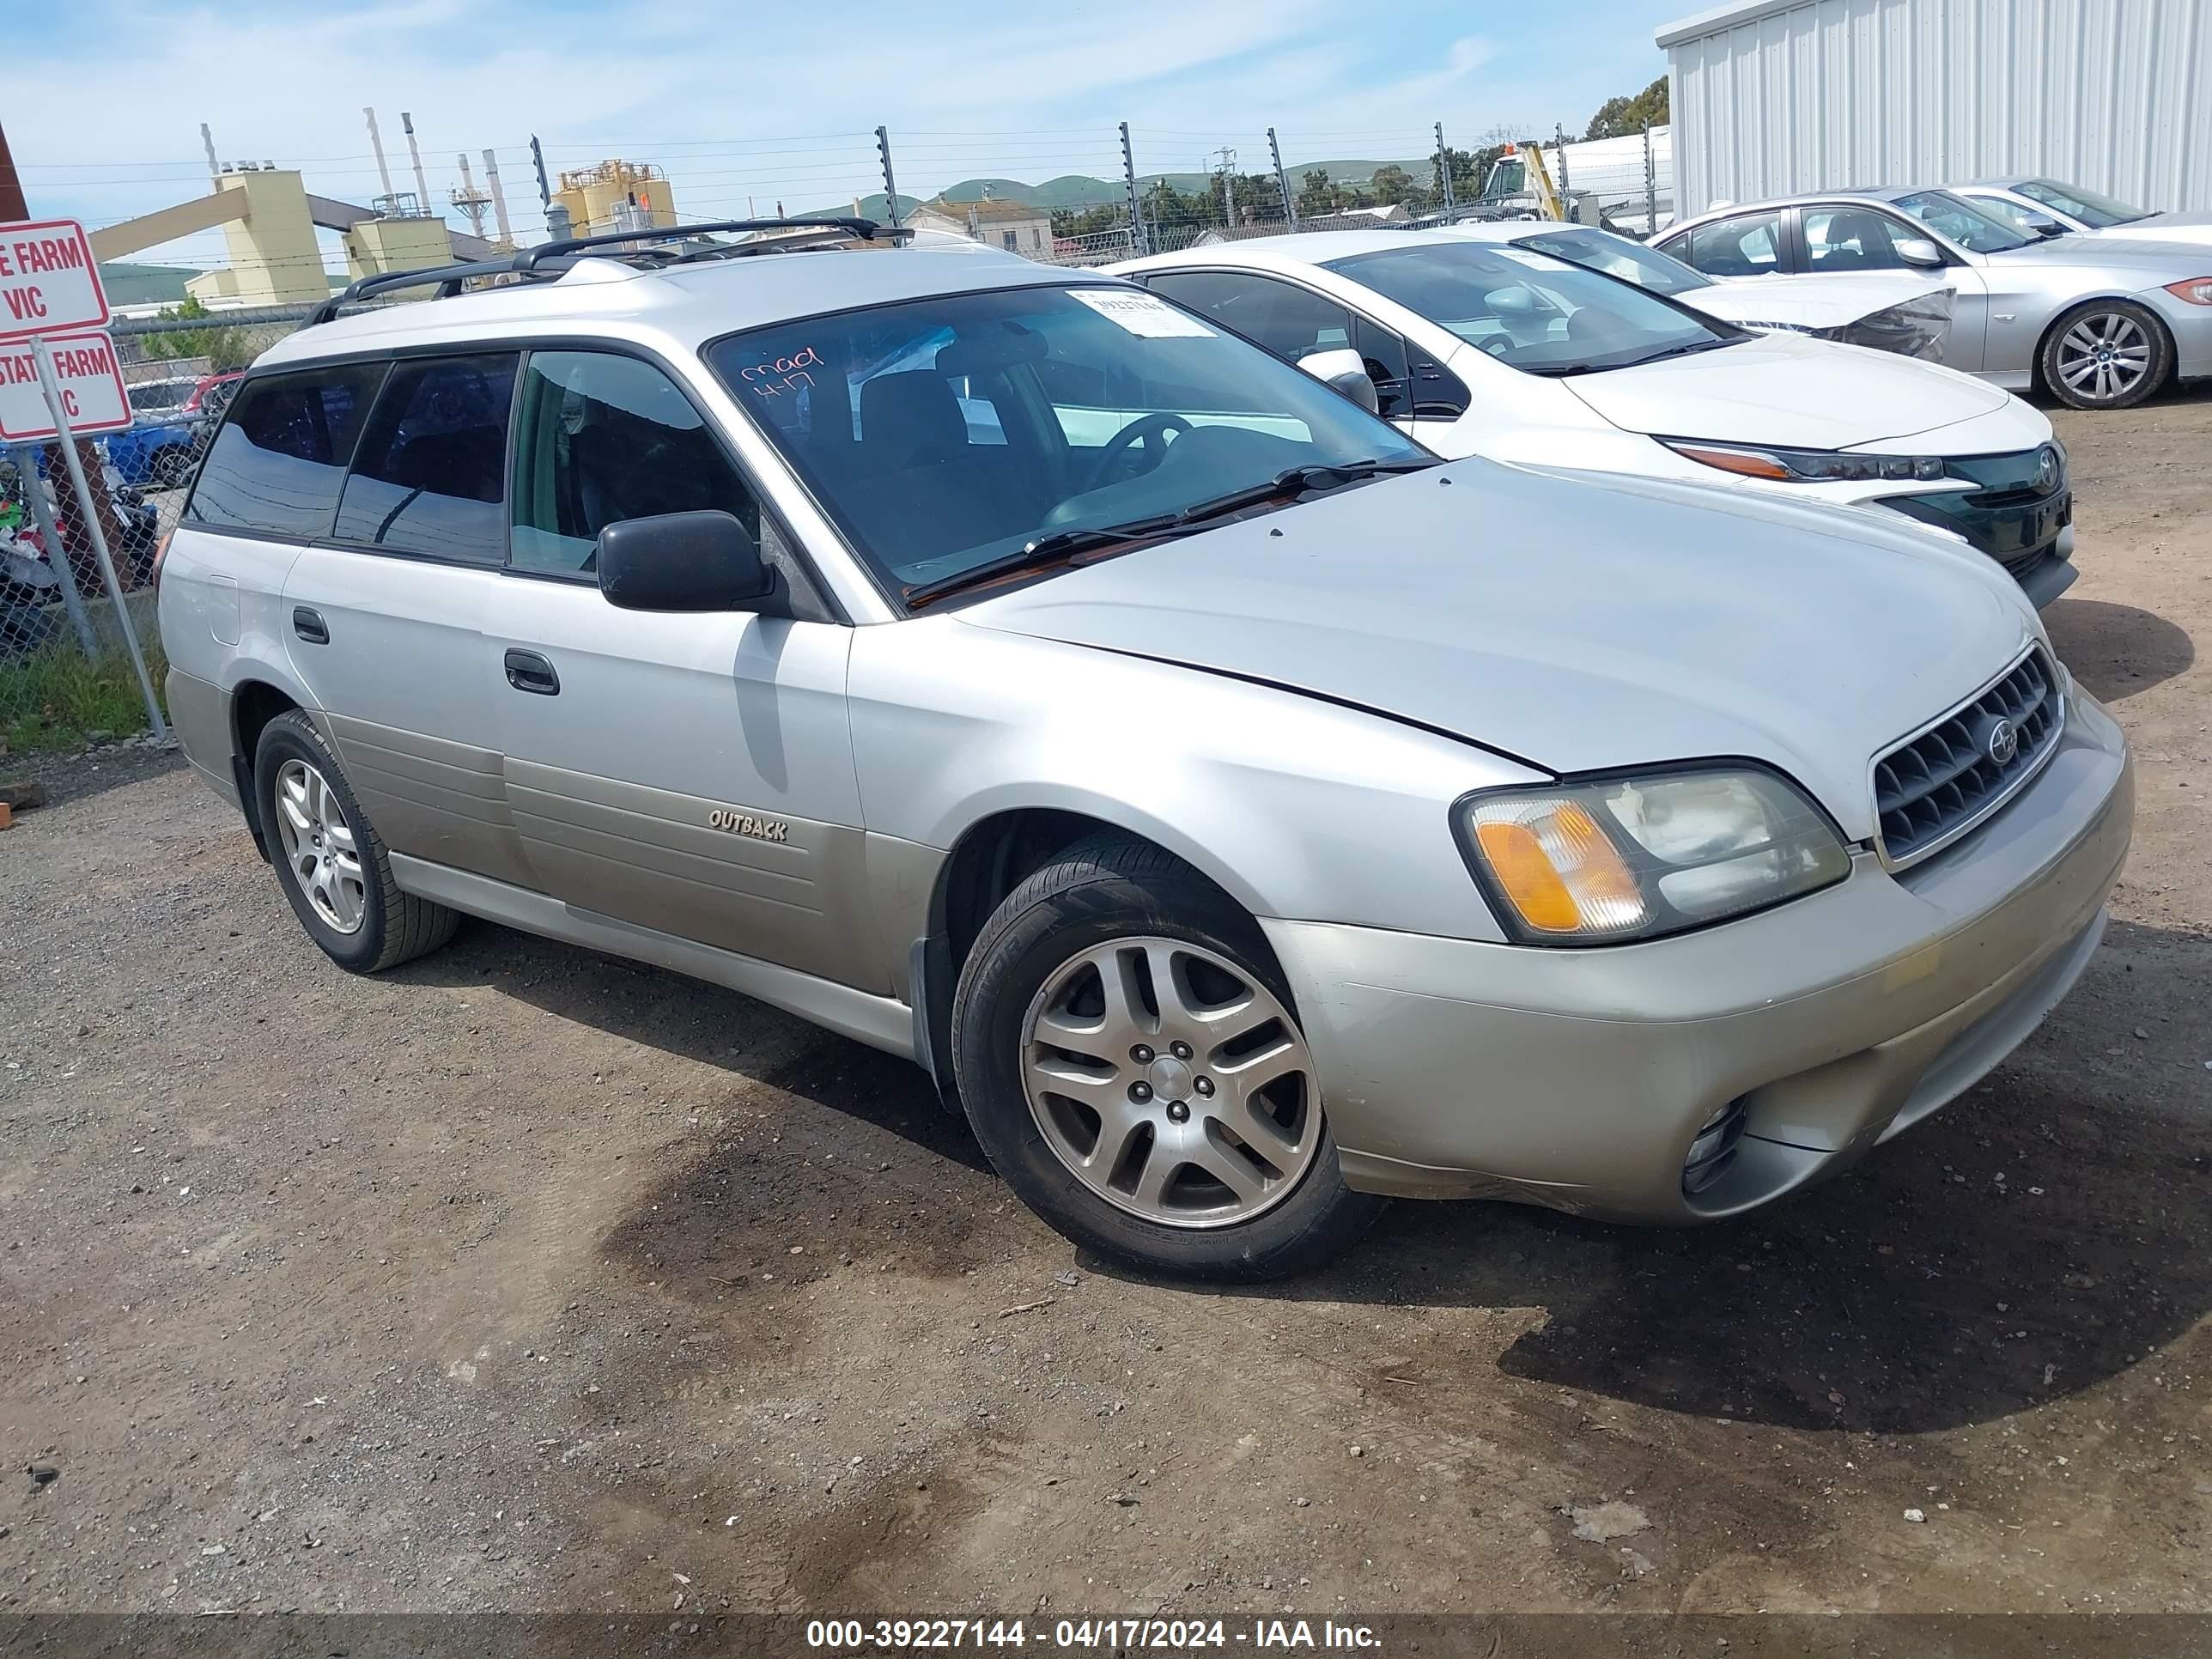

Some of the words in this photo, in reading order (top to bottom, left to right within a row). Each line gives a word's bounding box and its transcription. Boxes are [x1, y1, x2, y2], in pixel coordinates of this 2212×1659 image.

[13, 237, 83, 274] FARM
[3, 286, 47, 320] VIC
[52, 348, 111, 379] FARM
[753, 371, 816, 396] 4-17
[708, 809, 788, 842] OUTBACK
